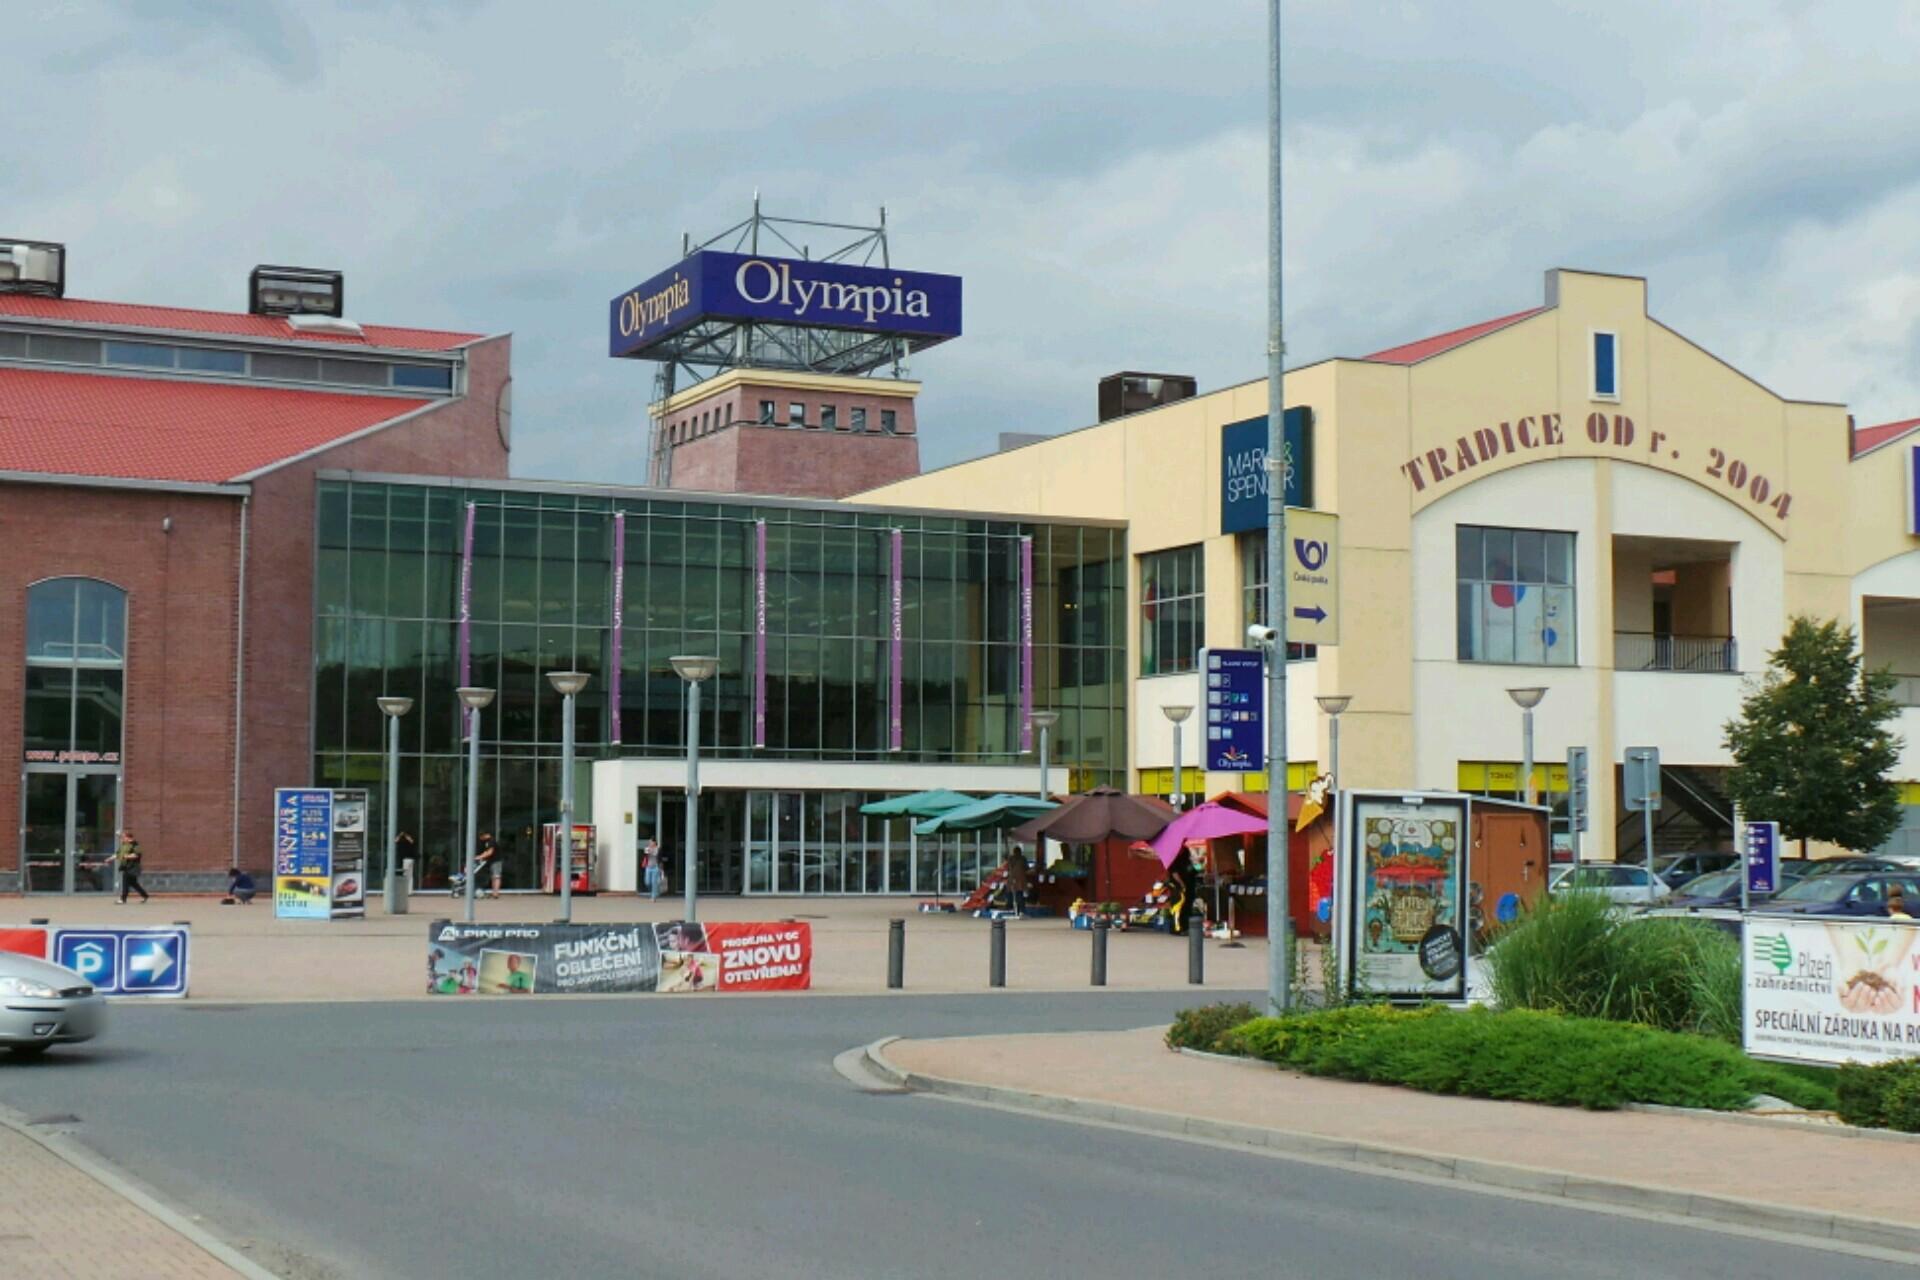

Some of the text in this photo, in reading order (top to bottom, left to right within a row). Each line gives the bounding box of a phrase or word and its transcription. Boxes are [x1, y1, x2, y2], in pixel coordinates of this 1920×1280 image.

[619, 272, 689, 338] Olympia
[735, 259, 931, 323] Olympia
[1228, 446, 1270, 478] MARK
[1400, 412, 1794, 520] TRADICE OD r. 2004
[1228, 466, 1296, 503] SPENR
[554, 927, 640, 960] FUNKČNÍ
[723, 942, 802, 969] ZNOVU
[556, 948, 641, 977] OBLEČENÍ
[724, 963, 802, 983] OTEVŘENA!
[1798, 951, 1832, 978] Plzeň
[1754, 1008, 1821, 1034] SPECIÁLNÍ
[1824, 1012, 1879, 1041] ZÁRUKA
[1883, 1021, 1903, 1043] NA
